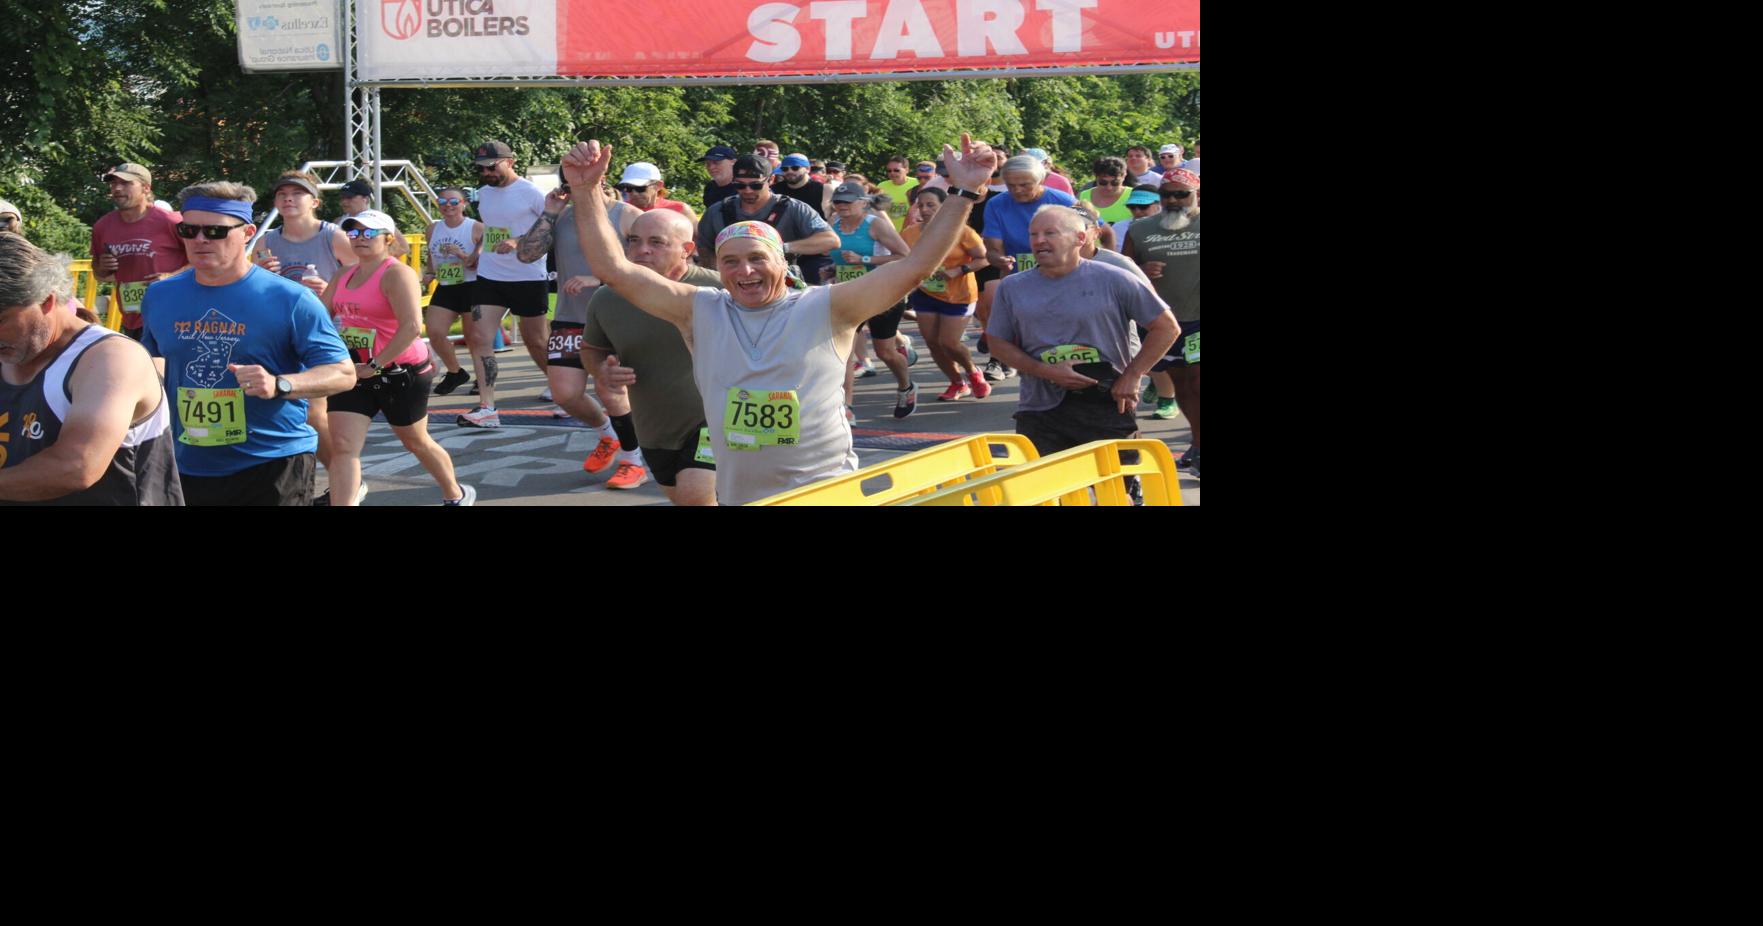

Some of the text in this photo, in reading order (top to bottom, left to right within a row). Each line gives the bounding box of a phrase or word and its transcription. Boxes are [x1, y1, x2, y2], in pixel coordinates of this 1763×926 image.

[427, 0, 494, 17] UTICA
[426, 16, 530, 38] BOILERS
[745, 0, 1098, 62] START
[1155, 31, 1200, 48] UT
[438, 267, 461, 279] 242
[123, 289, 145, 302] 838
[195, 320, 245, 336] RAGNAR
[339, 334, 369, 349] 559
[548, 335, 583, 352] 5346
[182, 400, 235, 423] 7491
[731, 401, 793, 429] 7583
